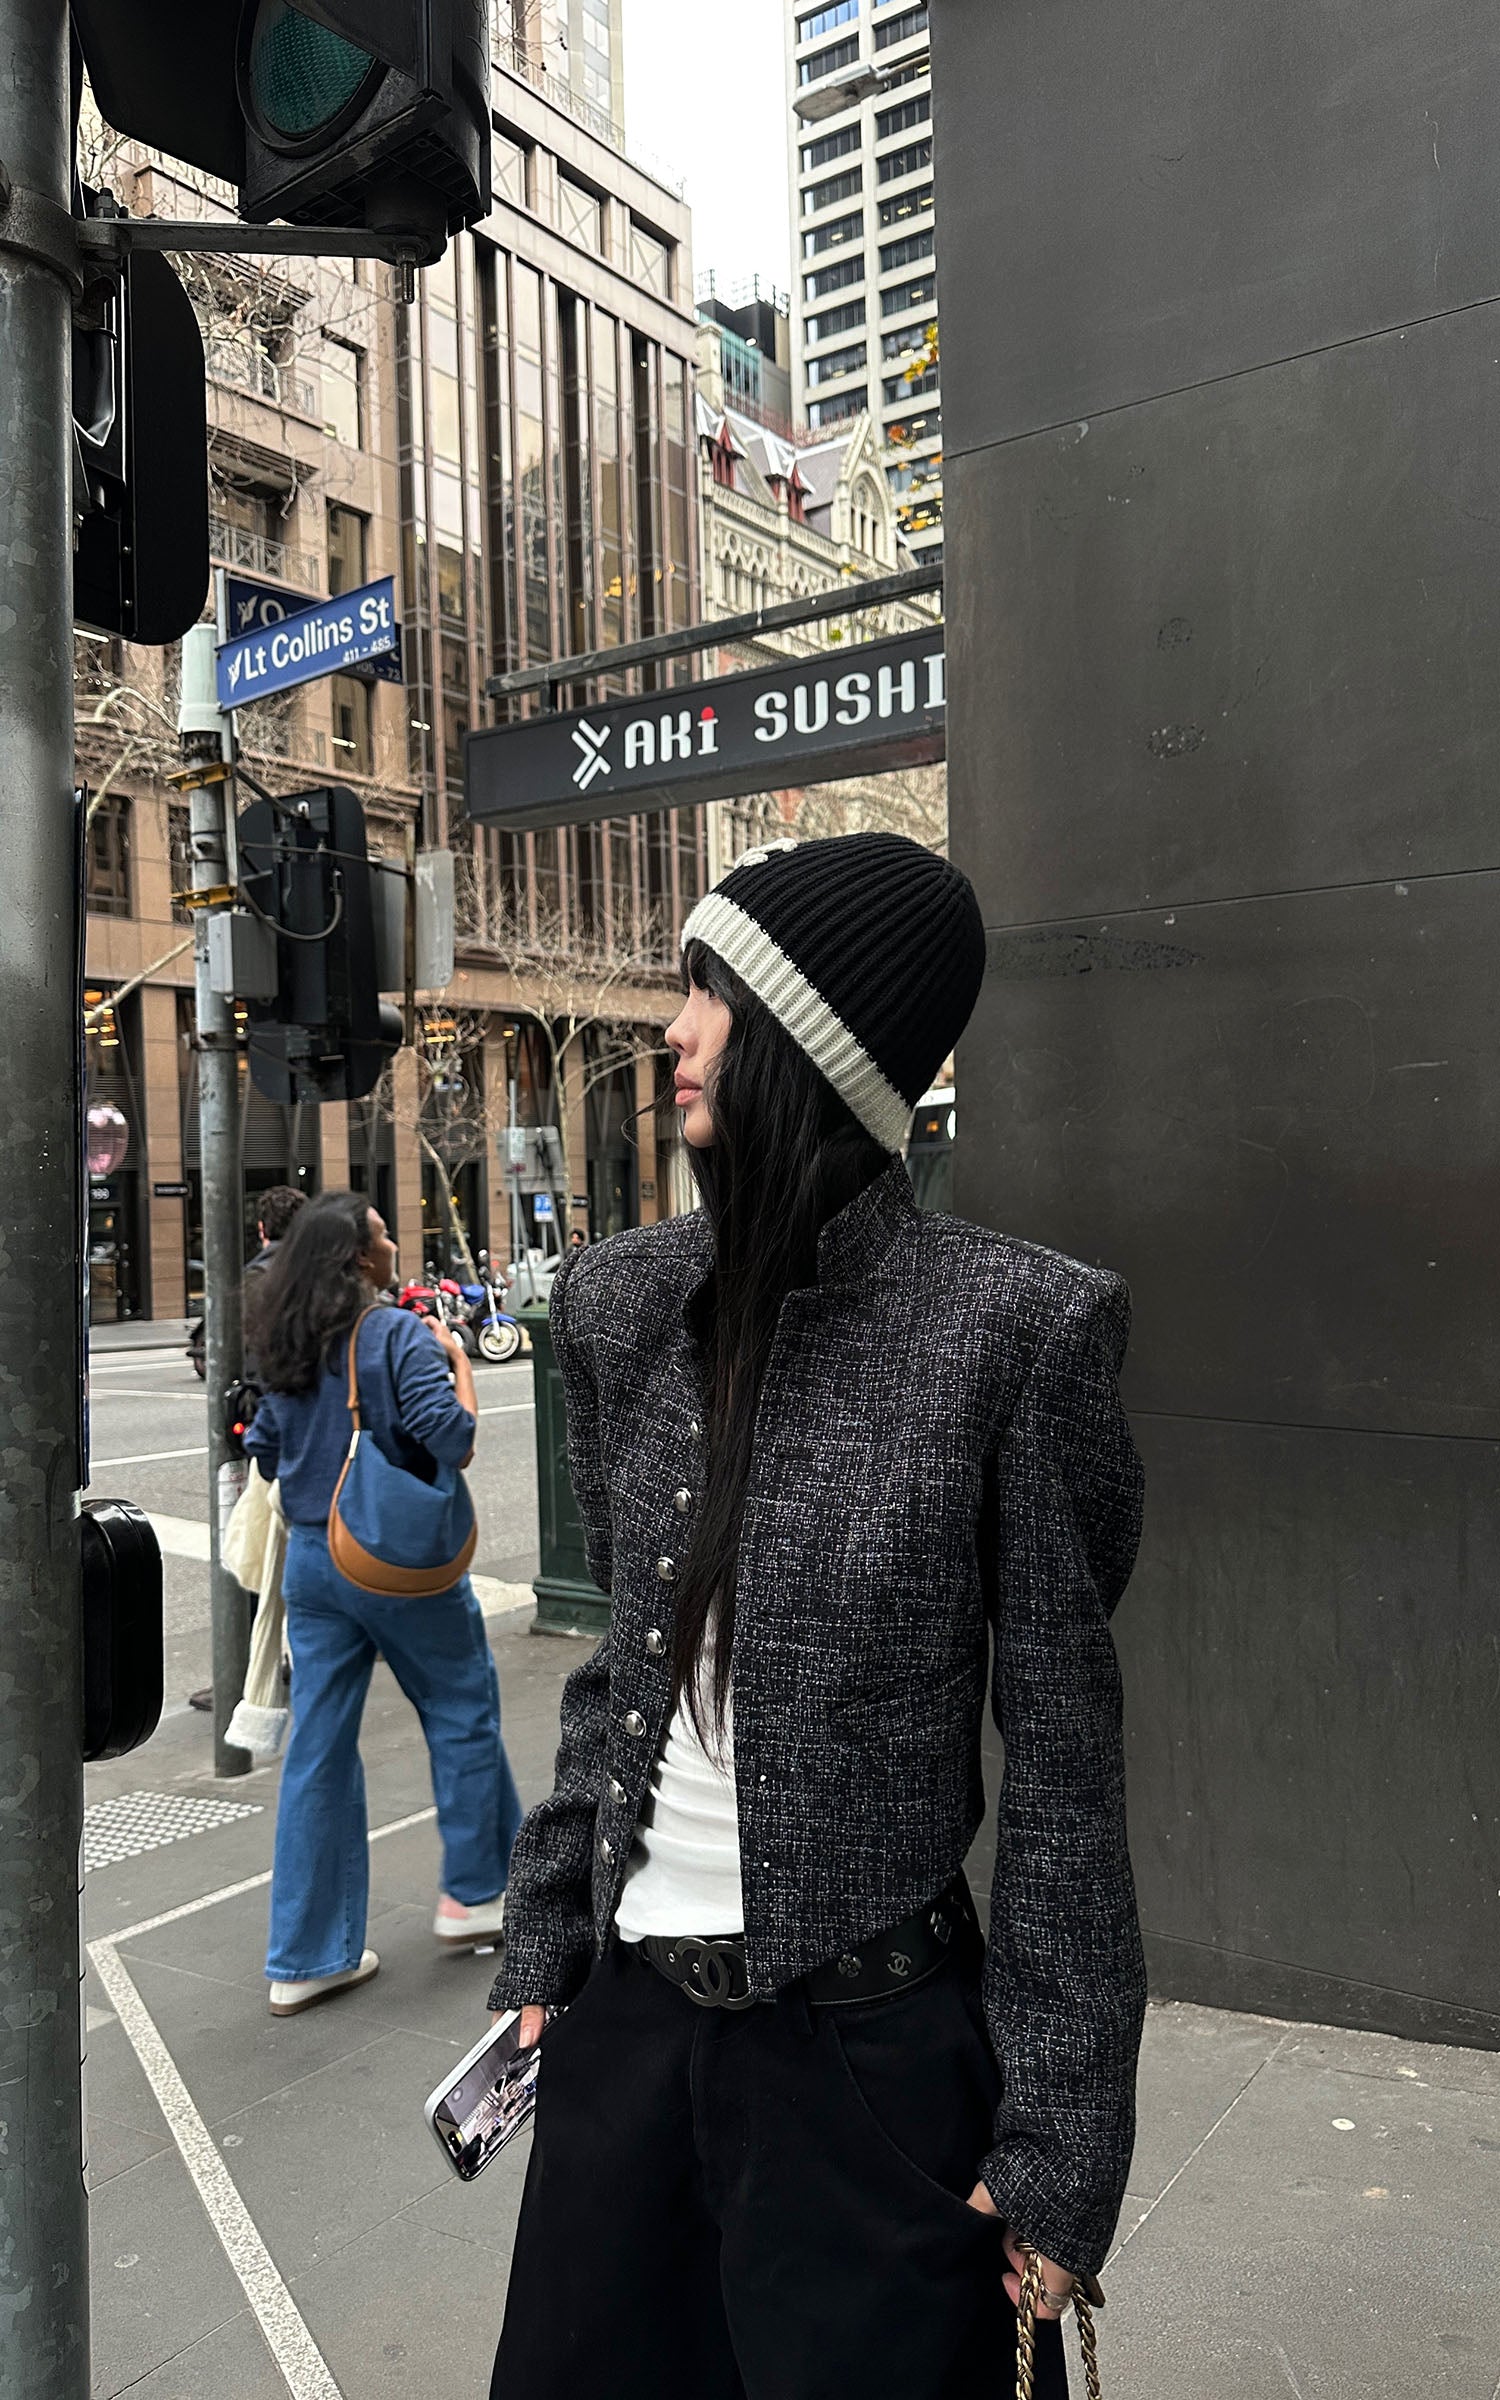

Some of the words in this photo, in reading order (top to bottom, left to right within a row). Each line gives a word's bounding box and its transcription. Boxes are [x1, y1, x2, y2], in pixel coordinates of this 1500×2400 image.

[244, 646, 267, 681] Lt
[271, 616, 354, 669] Collins
[359, 596, 391, 636] St
[753, 652, 947, 743] SUSHI
